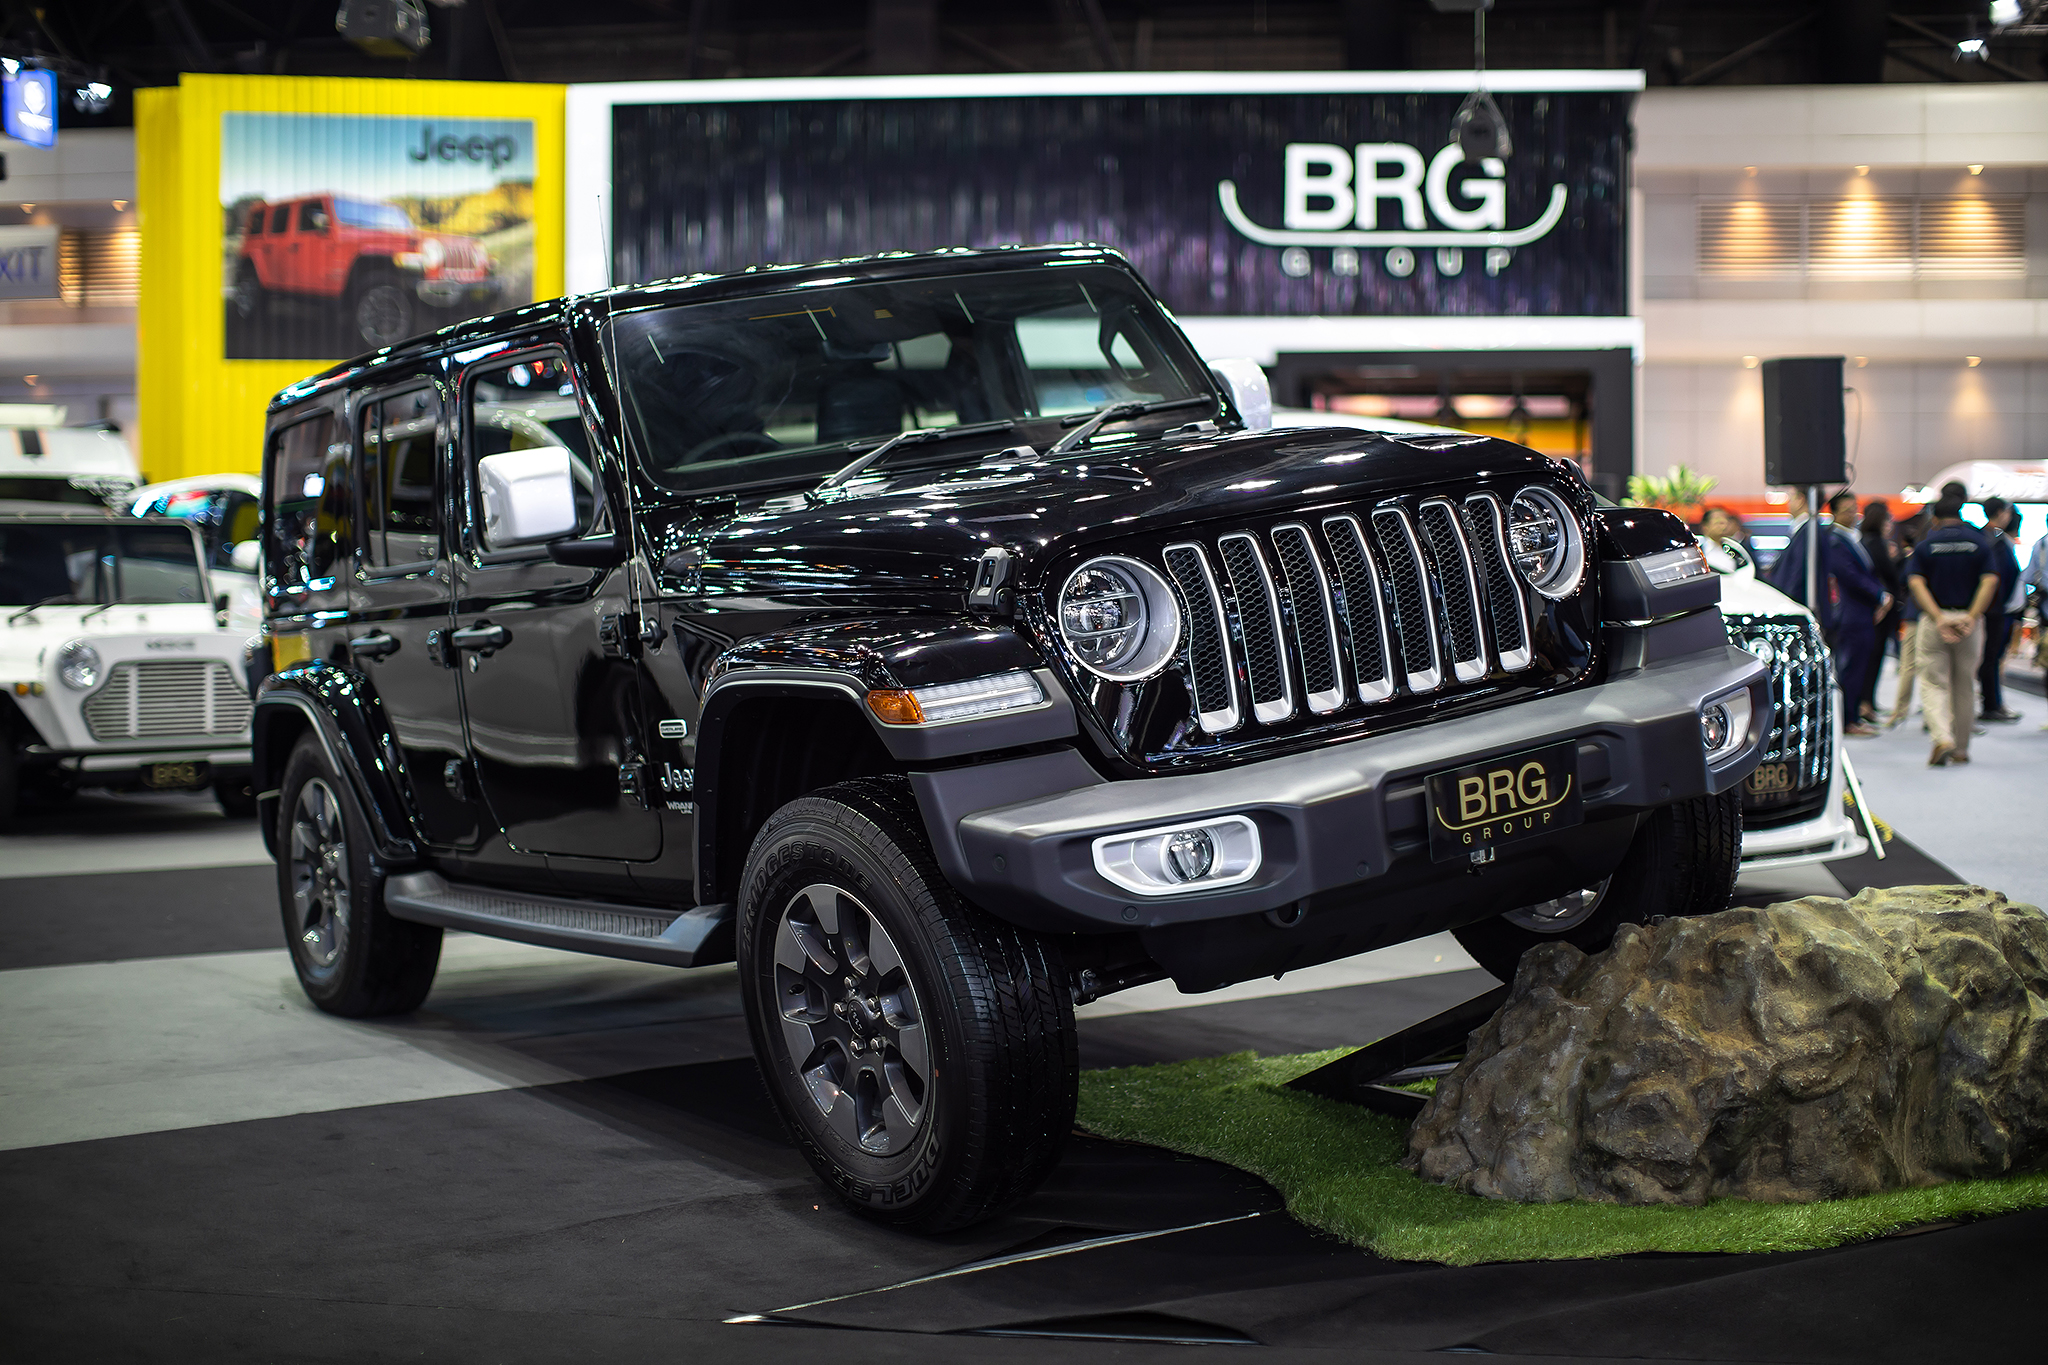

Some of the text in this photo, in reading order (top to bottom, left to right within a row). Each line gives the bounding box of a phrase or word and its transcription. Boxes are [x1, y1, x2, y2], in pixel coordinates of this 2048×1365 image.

[408, 124, 516, 169] Jeep
[1284, 142, 1507, 231] BRG
[1281, 247, 1512, 277] GROUP
[1458, 761, 1548, 822] BRG
[1754, 763, 1788, 790] BRG
[1463, 812, 1551, 844] GROUP
